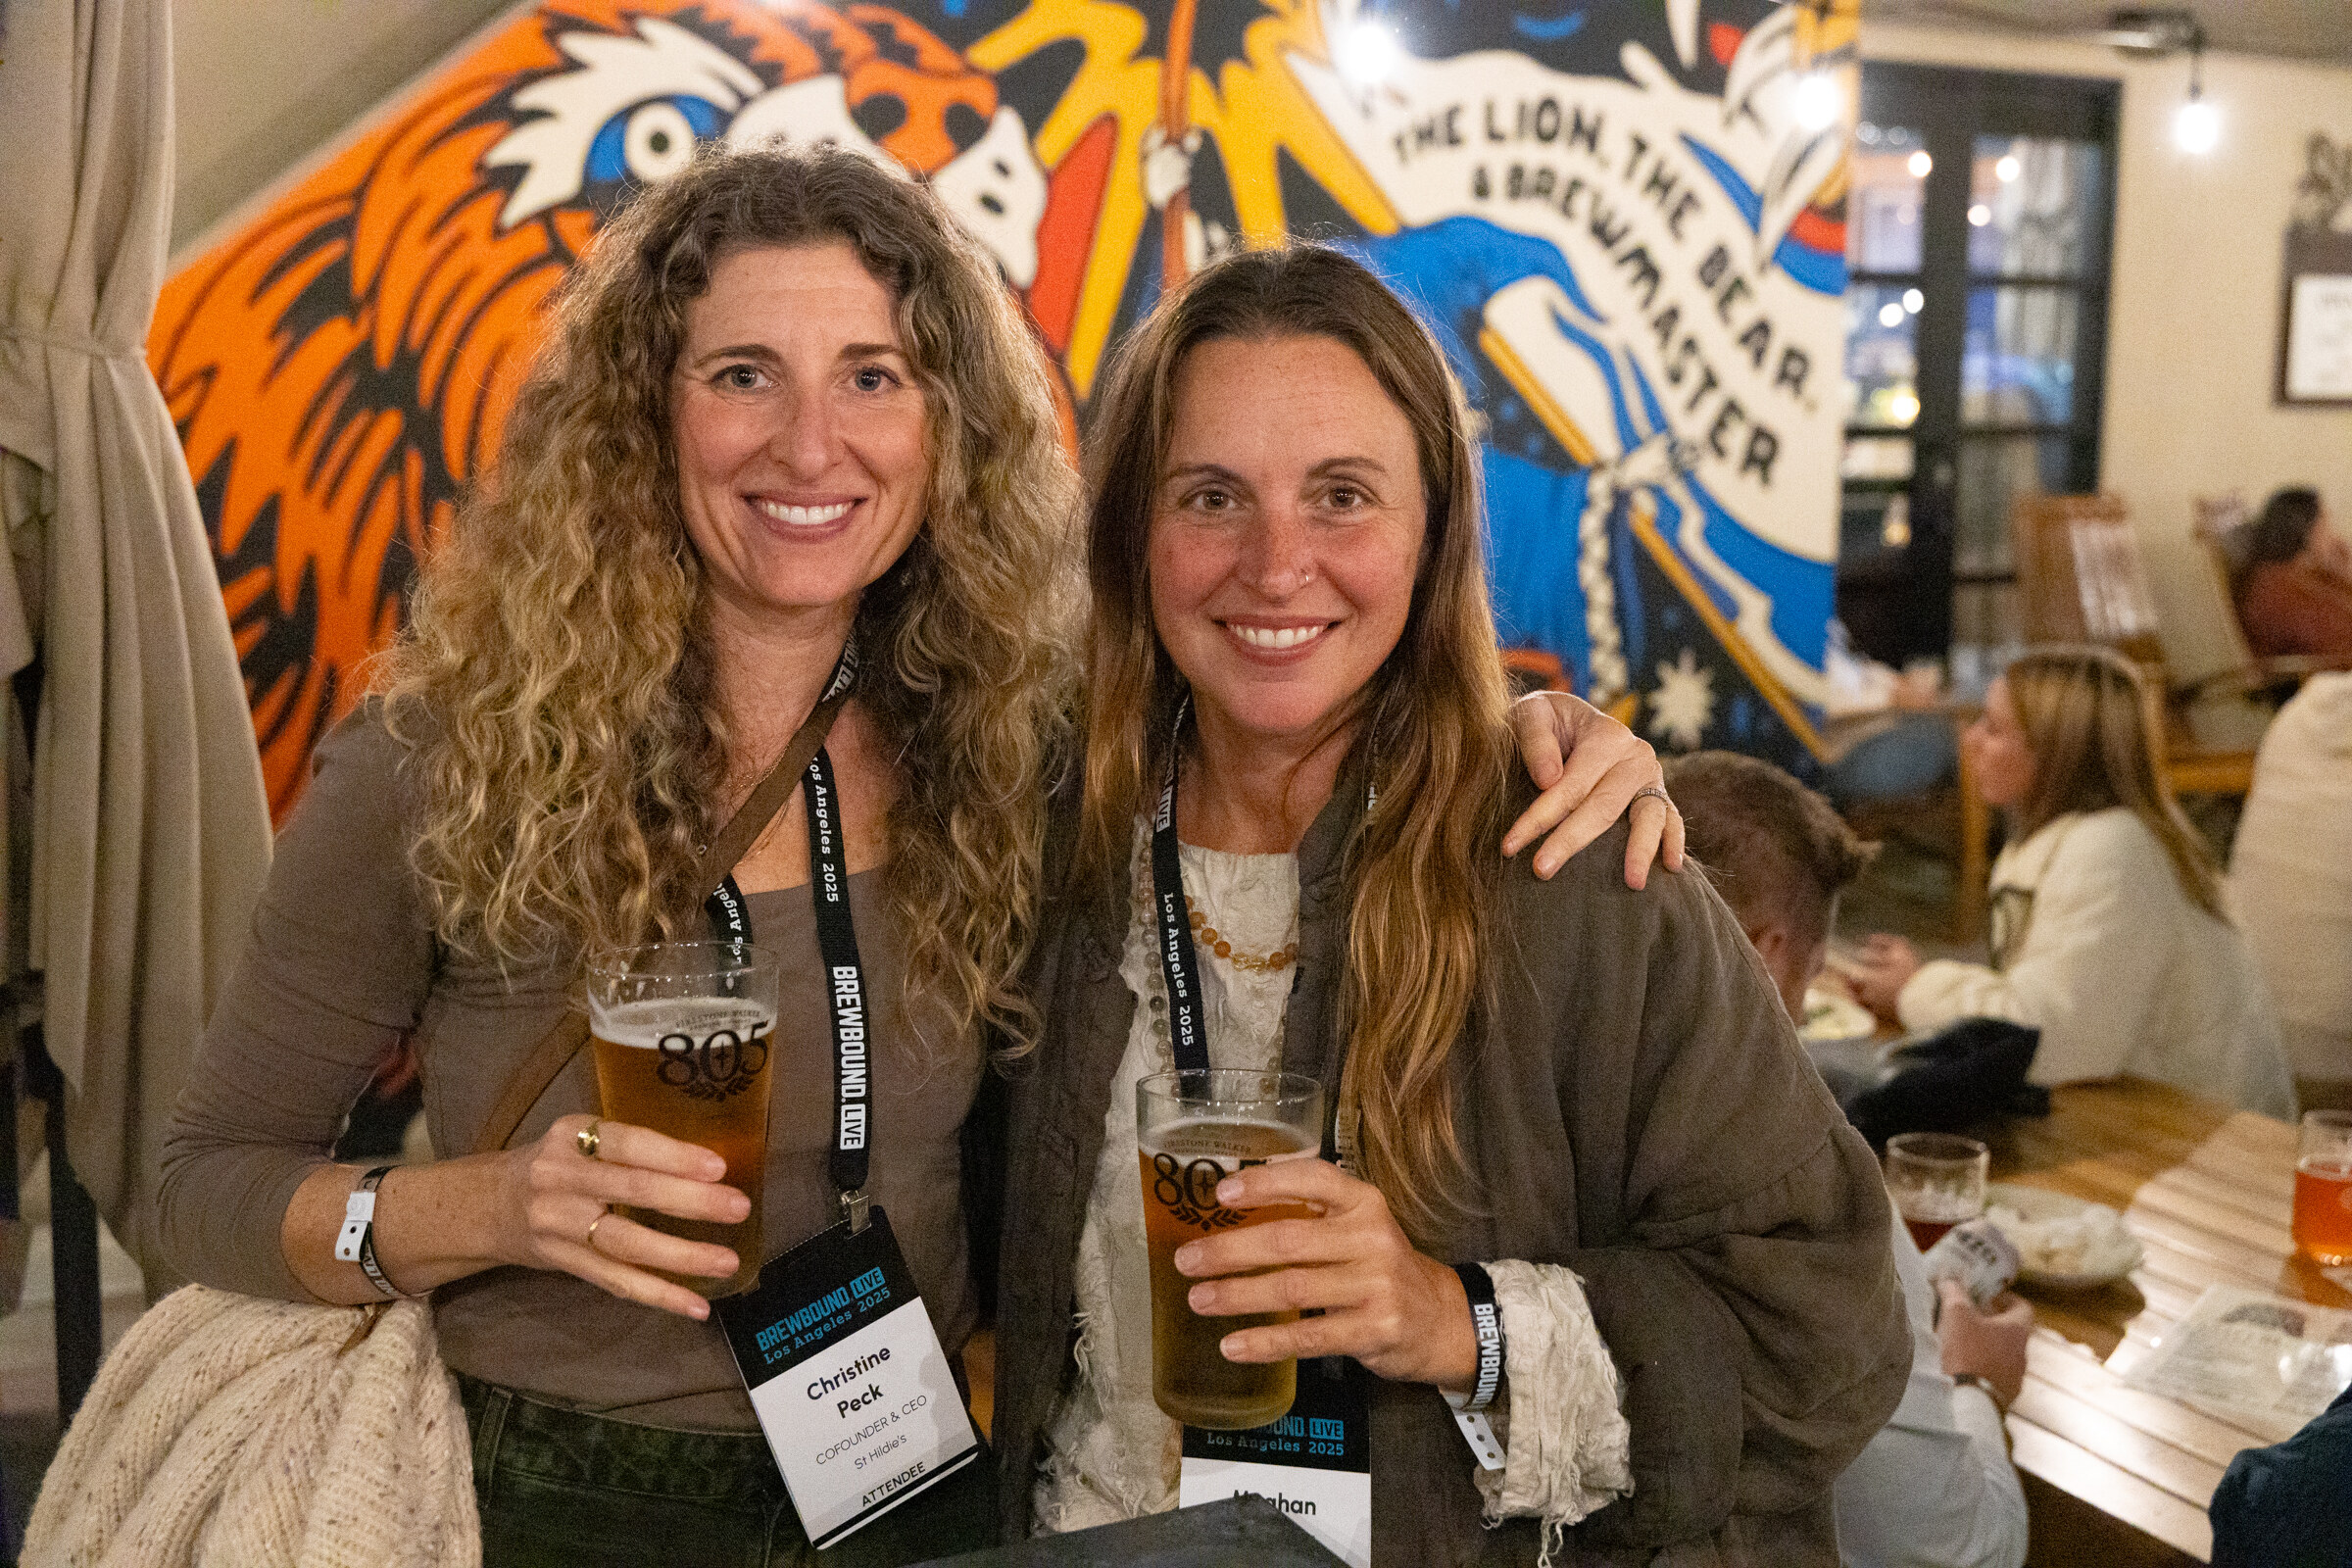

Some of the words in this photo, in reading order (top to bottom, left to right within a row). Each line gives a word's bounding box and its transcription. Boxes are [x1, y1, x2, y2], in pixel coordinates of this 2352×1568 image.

[1392, 102, 1464, 165] THE
[1620, 131, 1702, 241] THE
[1473, 165, 1490, 201] &
[1506, 165, 1782, 489] BREWMASTER
[808, 756, 822, 781] os
[815, 785, 832, 855] Angeles
[822, 862, 839, 903] 2025
[1163, 892, 1175, 923] Los
[1168, 928, 1188, 999] Angeles
[1179, 1004, 1194, 1047] 2025
[657, 1019, 768, 1086] 805
[841, 1104, 865, 1150] LIVE
[851, 1267, 884, 1298] LIVE
[764, 1345, 791, 1364] Los
[795, 1310, 853, 1349] Angeles
[858, 1286, 891, 1312] 2025
[807, 1348, 891, 1400] Christine
[837, 1384, 884, 1418] Peck
[816, 1417, 890, 1464] COFOUNDER
[891, 1411, 901, 1422] &
[902, 1395, 927, 1415] CEO
[855, 1456, 867, 1469] St
[868, 1434, 907, 1462] Hildie's
[1206, 1432, 1233, 1446] Los
[1237, 1434, 1300, 1452] Angeles
[1308, 1441, 1345, 1456] 2025
[1309, 1418, 1344, 1440] LIVE
[862, 1461, 926, 1507] ATTENDEE
